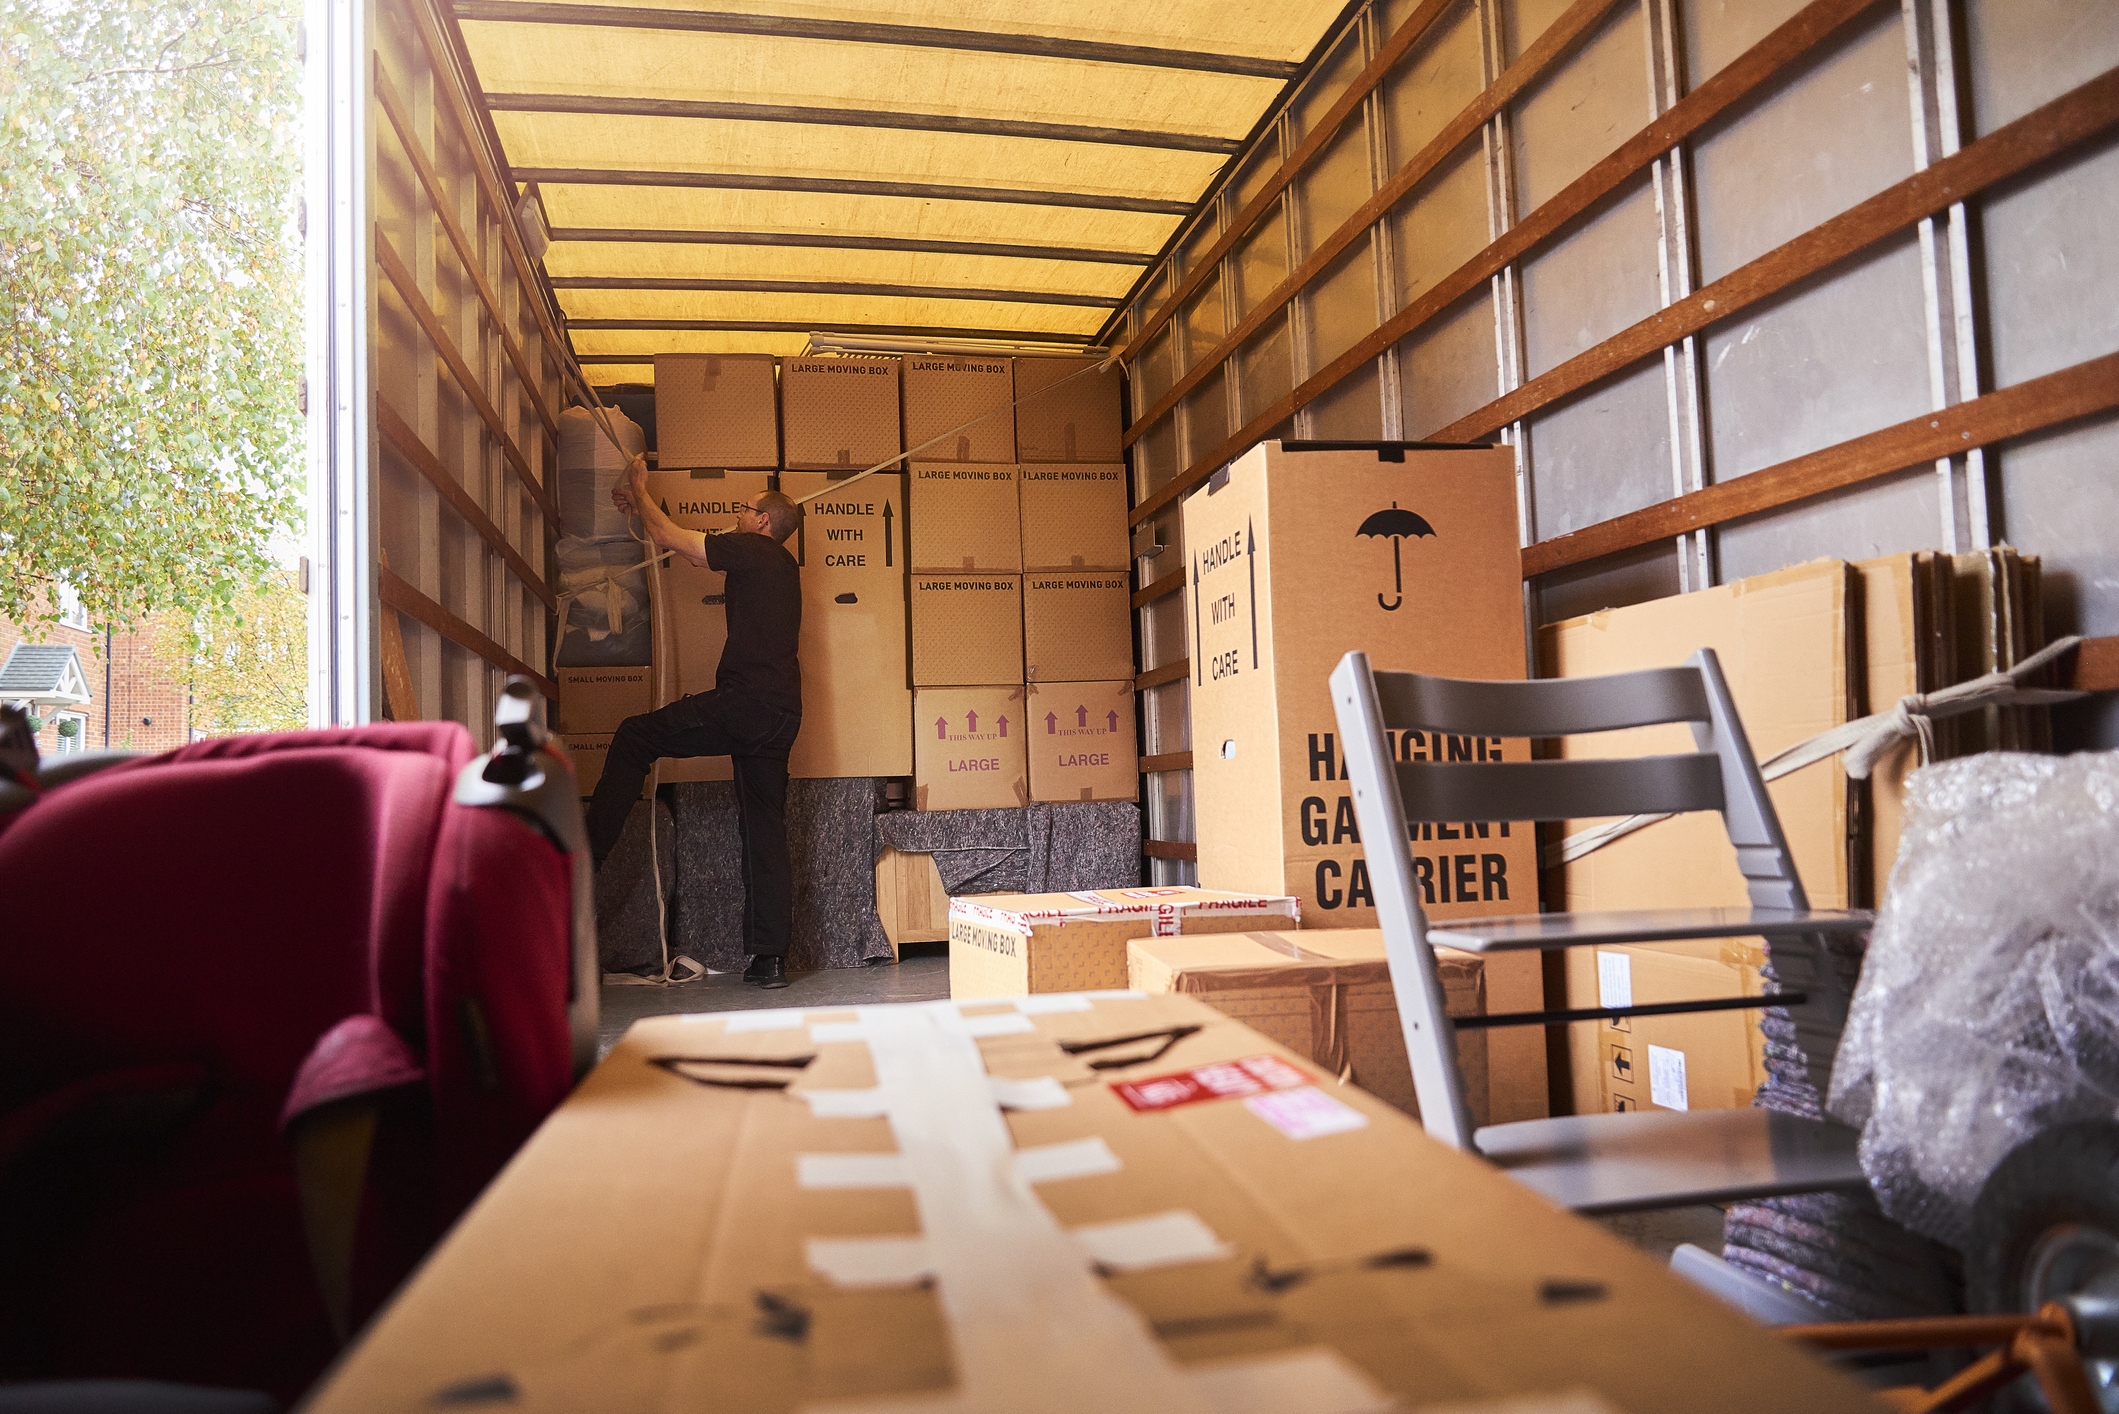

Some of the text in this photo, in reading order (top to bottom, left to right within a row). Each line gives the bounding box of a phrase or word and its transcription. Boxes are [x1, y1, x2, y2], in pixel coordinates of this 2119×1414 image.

[791, 363, 889, 375] LARGE MOVING BOX
[911, 362, 944, 372] LARGE
[985, 364, 1005, 374] BOX
[918, 470, 1012, 481] LARGE MOVING BOX
[1028, 471, 1119, 481] LARGE MOVING BOX
[678, 502, 741, 514] HANDLE
[814, 502, 875, 515] HANDLE
[826, 529, 863, 541] WITH
[1203, 530, 1241, 576] HANDLE
[824, 555, 866, 567] CARE
[919, 581, 1014, 591] LARGE MOVING BOX
[1032, 580, 1124, 590] LARGE MOVING BOX
[1211, 592, 1236, 626] WITH
[1212, 649, 1239, 681] CARE
[568, 676, 595, 684] SMALL
[948, 734, 967, 742] THIS
[1058, 728, 1077, 736] THIS
[1078, 728, 1095, 736] WAY
[948, 759, 1000, 772] LARGE
[1058, 753, 1110, 767] LARGE
[1316, 853, 1510, 910] CARIER
[952, 921, 1017, 957] LARGE MOVING BOX
